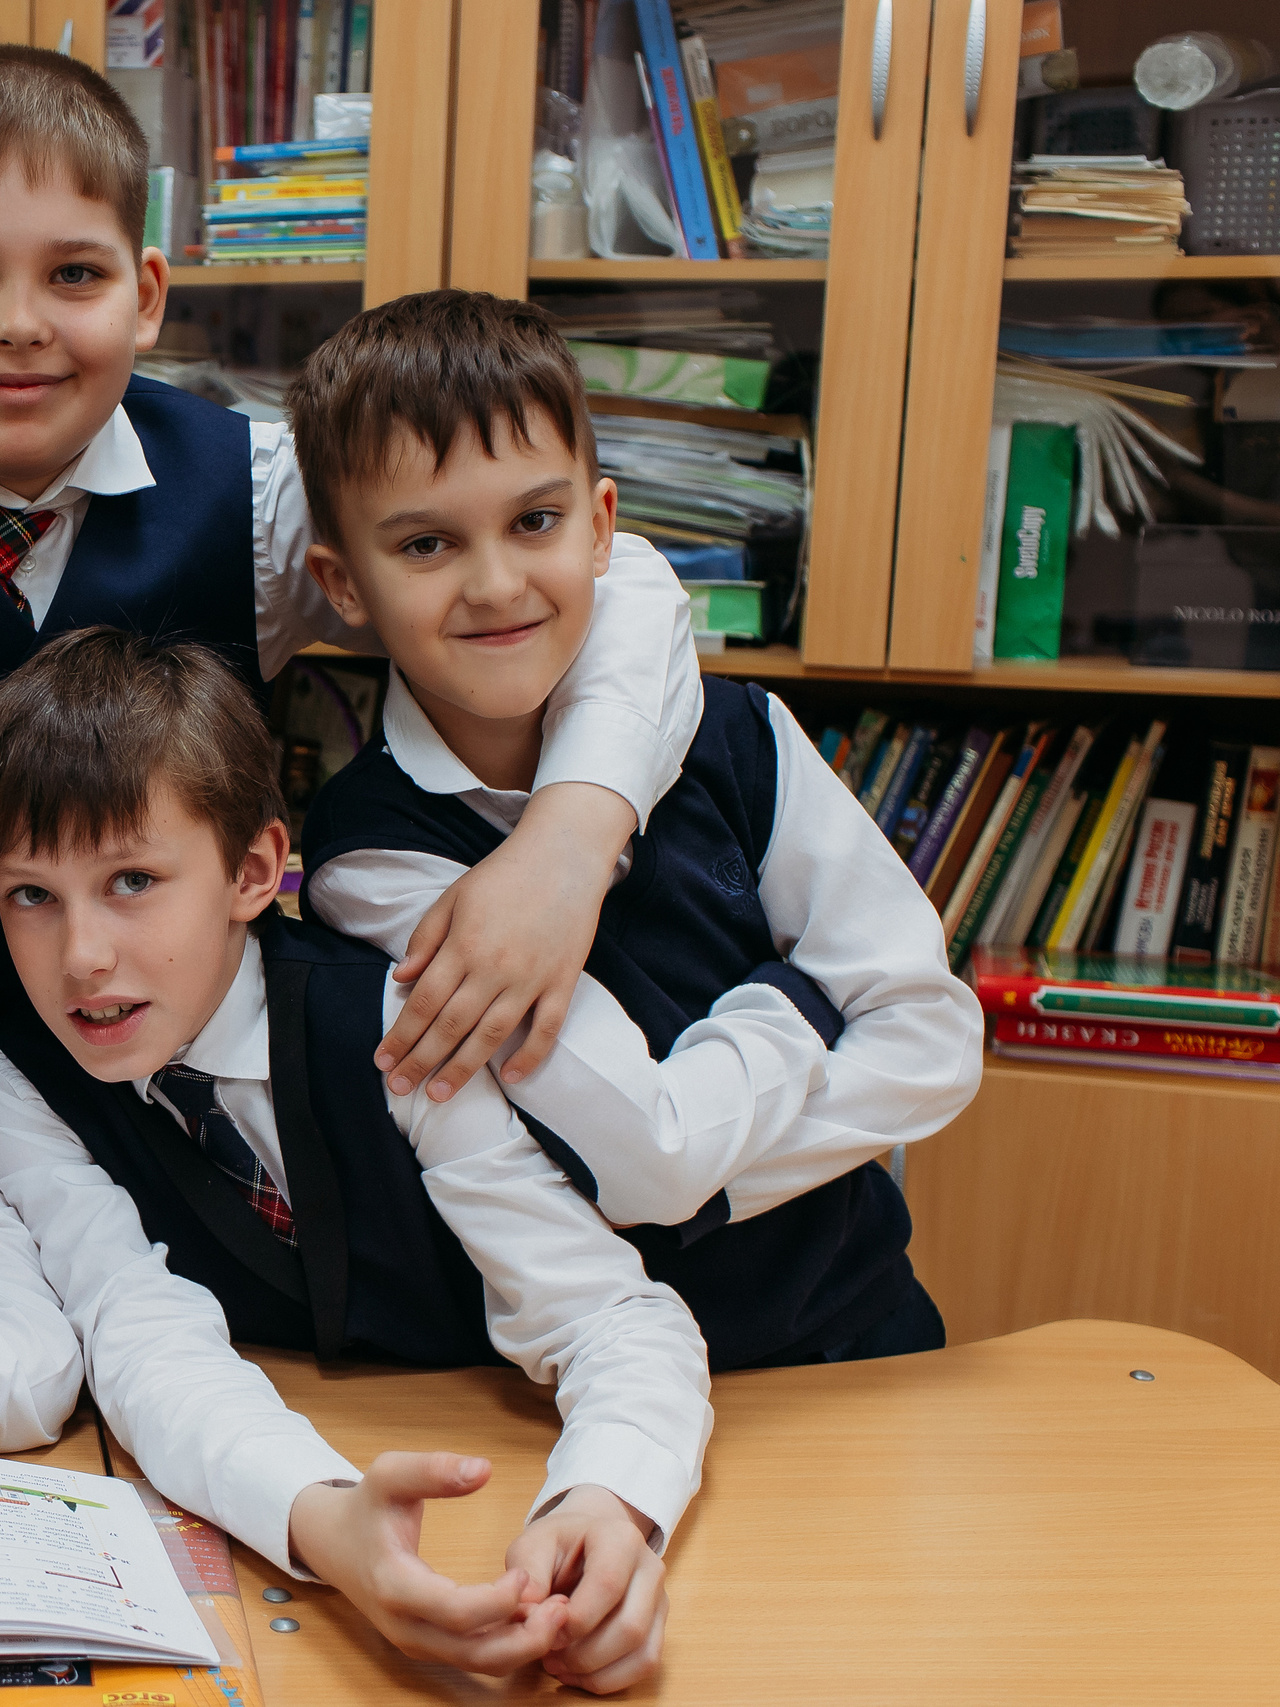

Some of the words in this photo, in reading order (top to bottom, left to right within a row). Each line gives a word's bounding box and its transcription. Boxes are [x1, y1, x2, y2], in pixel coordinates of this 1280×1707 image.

[1012, 505, 1047, 579] SvetoCopy
[1017, 1022, 1140, 1046] СКАЗКИ
[107, 1694, 171, 1702] ФГОС
